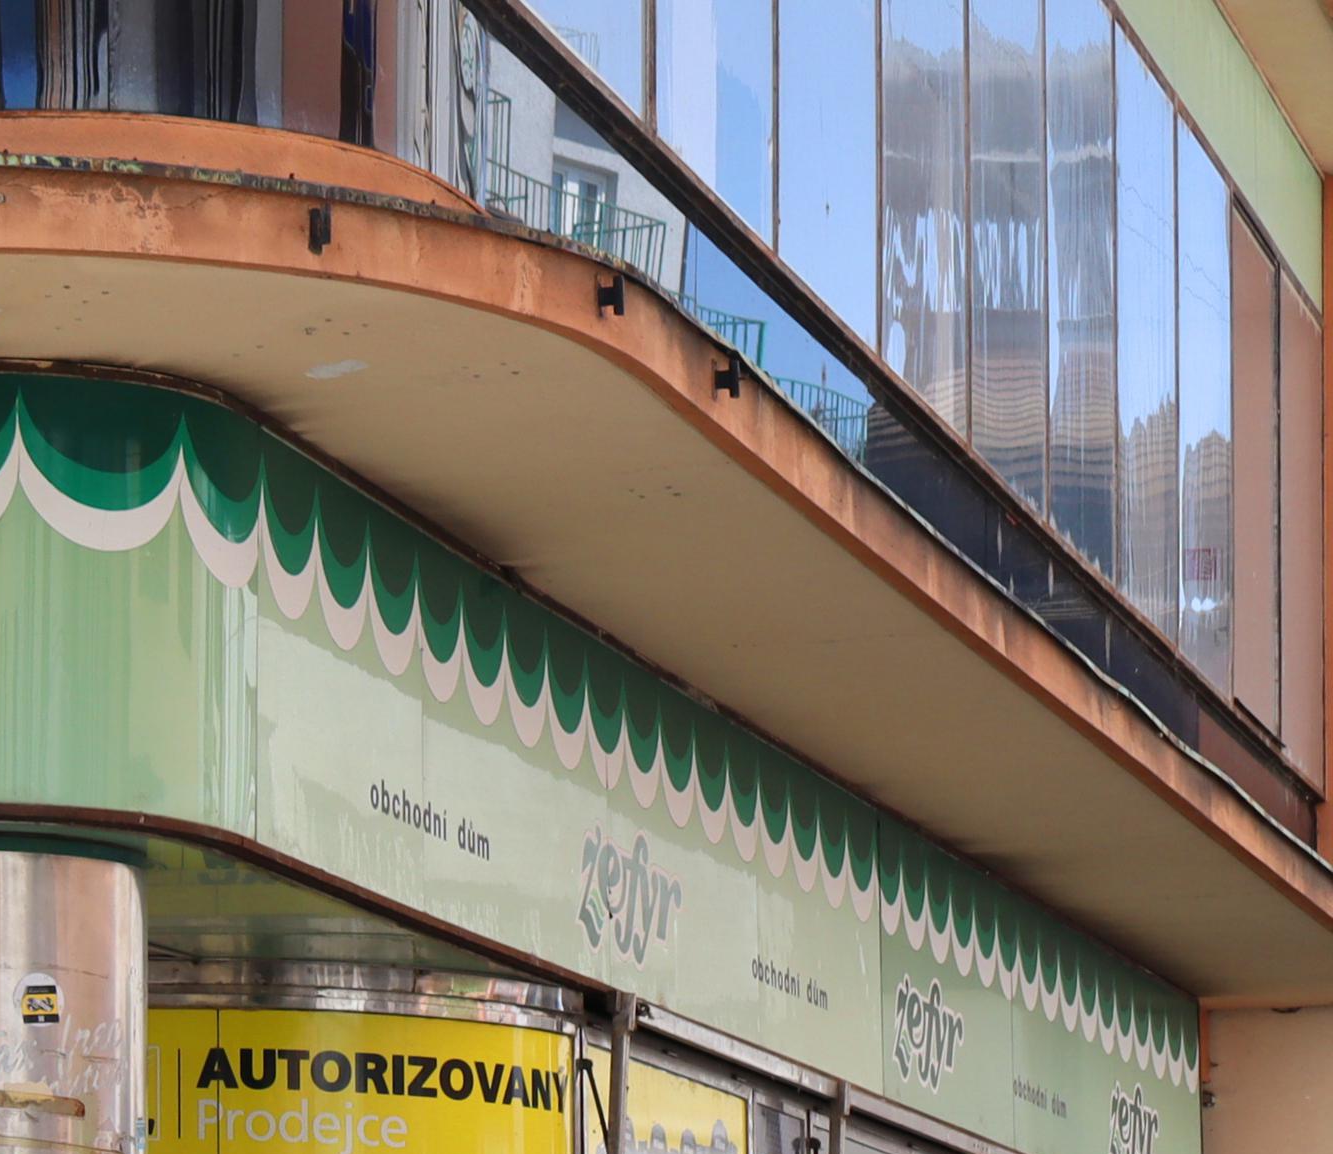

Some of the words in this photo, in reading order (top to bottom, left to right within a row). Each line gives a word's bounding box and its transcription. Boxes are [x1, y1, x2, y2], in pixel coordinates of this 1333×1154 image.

[369, 779, 447, 842] obchodní
[457, 816, 491, 861] dům
[751, 955, 801, 999] obchodní
